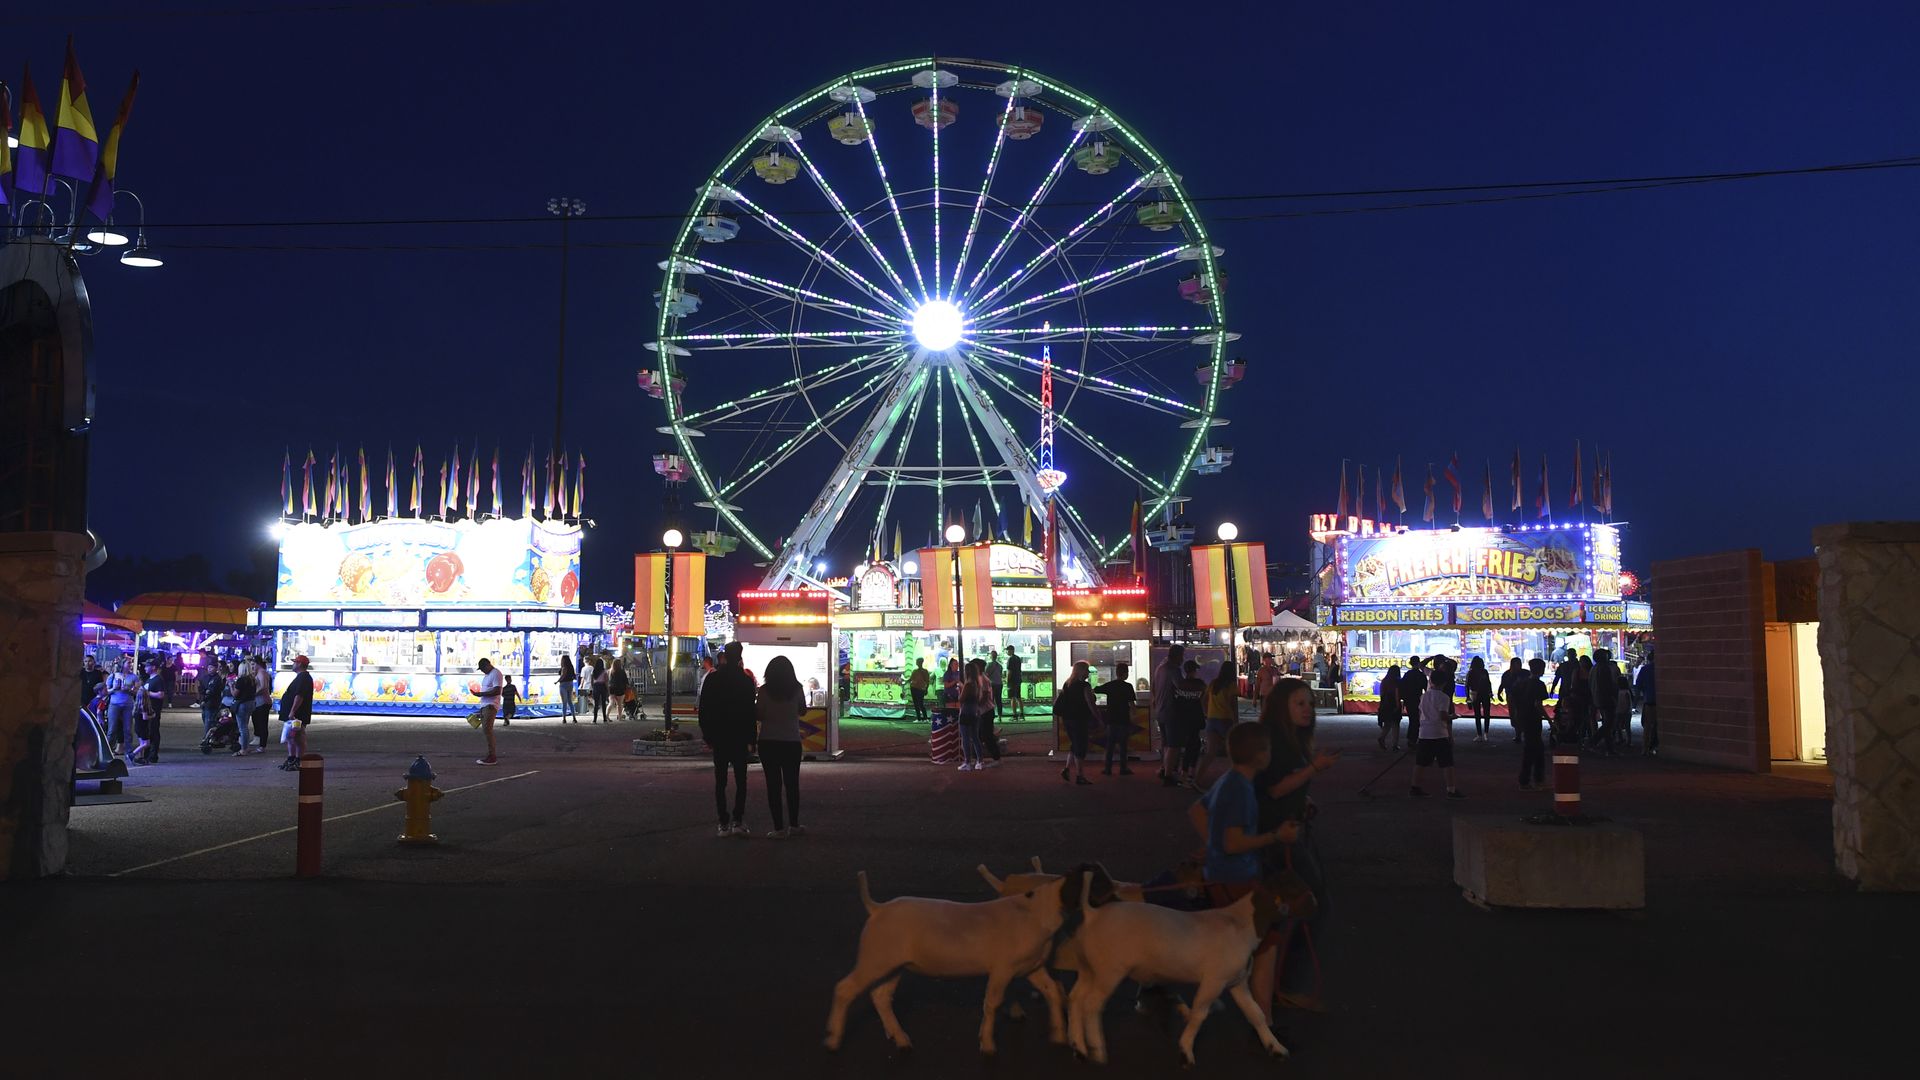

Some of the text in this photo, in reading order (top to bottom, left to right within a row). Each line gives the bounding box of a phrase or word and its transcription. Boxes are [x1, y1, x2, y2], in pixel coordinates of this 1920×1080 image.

[1385, 547, 1537, 588] FRENCH FRIES
[1340, 609, 1398, 622] RIBBON
[1401, 608, 1444, 621] FRIES
[1471, 606, 1565, 621] CORN DOGS
